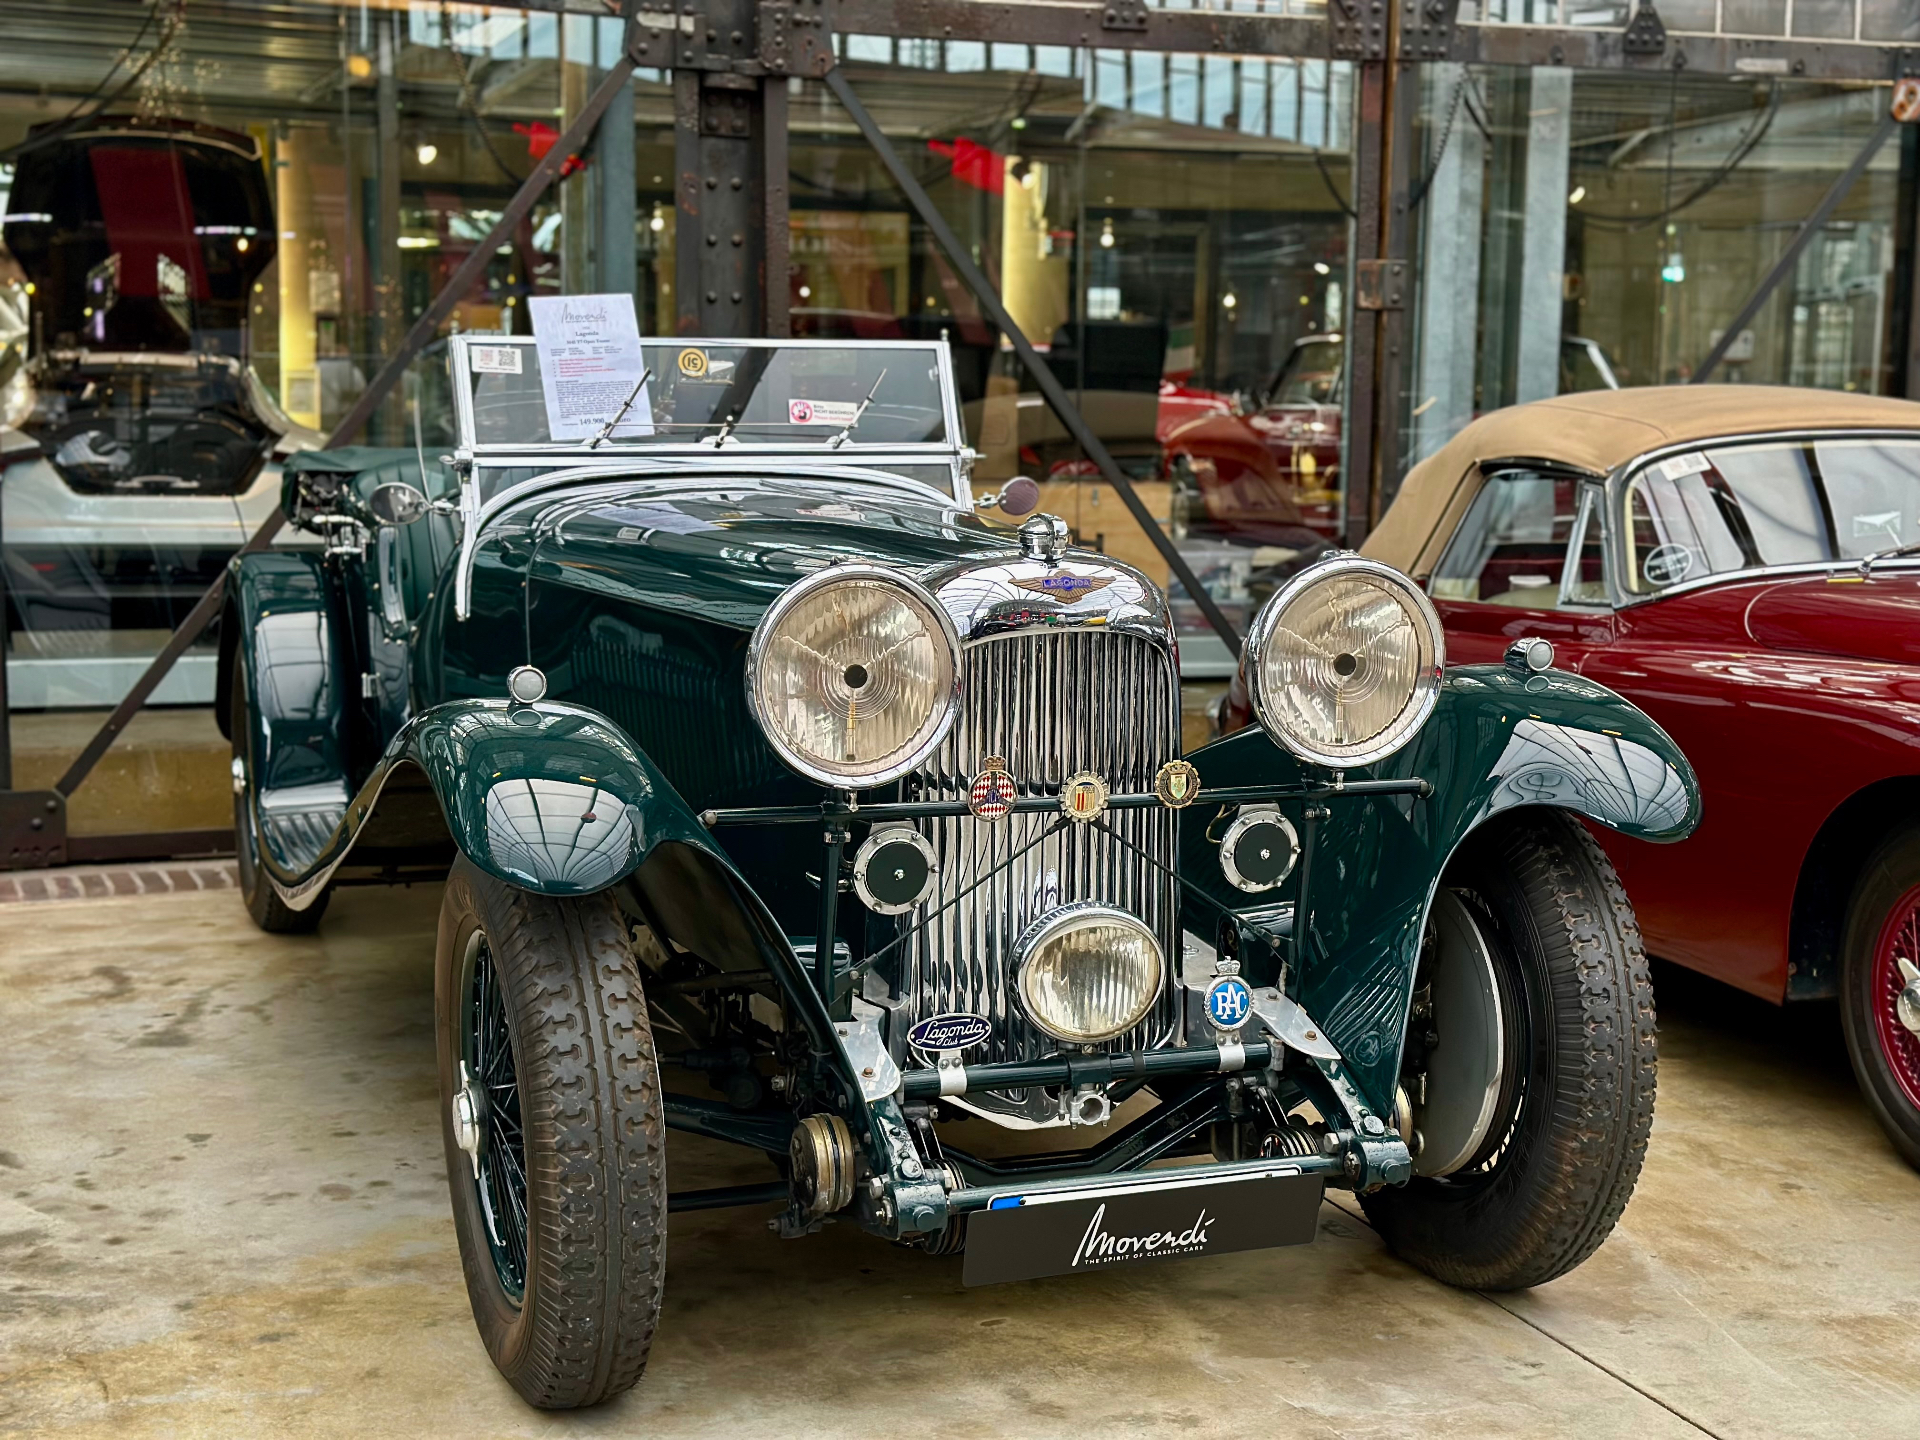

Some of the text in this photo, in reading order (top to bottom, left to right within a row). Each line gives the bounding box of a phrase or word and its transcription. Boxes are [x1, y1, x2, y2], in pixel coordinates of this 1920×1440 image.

[1043, 578, 1092, 588] LAGONDA
[1215, 983, 1247, 1019] RAC
[916, 1018, 985, 1046] Lagonda
[941, 1037, 959, 1047] Club
[1071, 1202, 1216, 1267] Movendi
[1103, 1254, 1130, 1263] SPIRIT
[1146, 1248, 1180, 1257] CLASSIC
[1183, 1245, 1204, 1253] CARS
